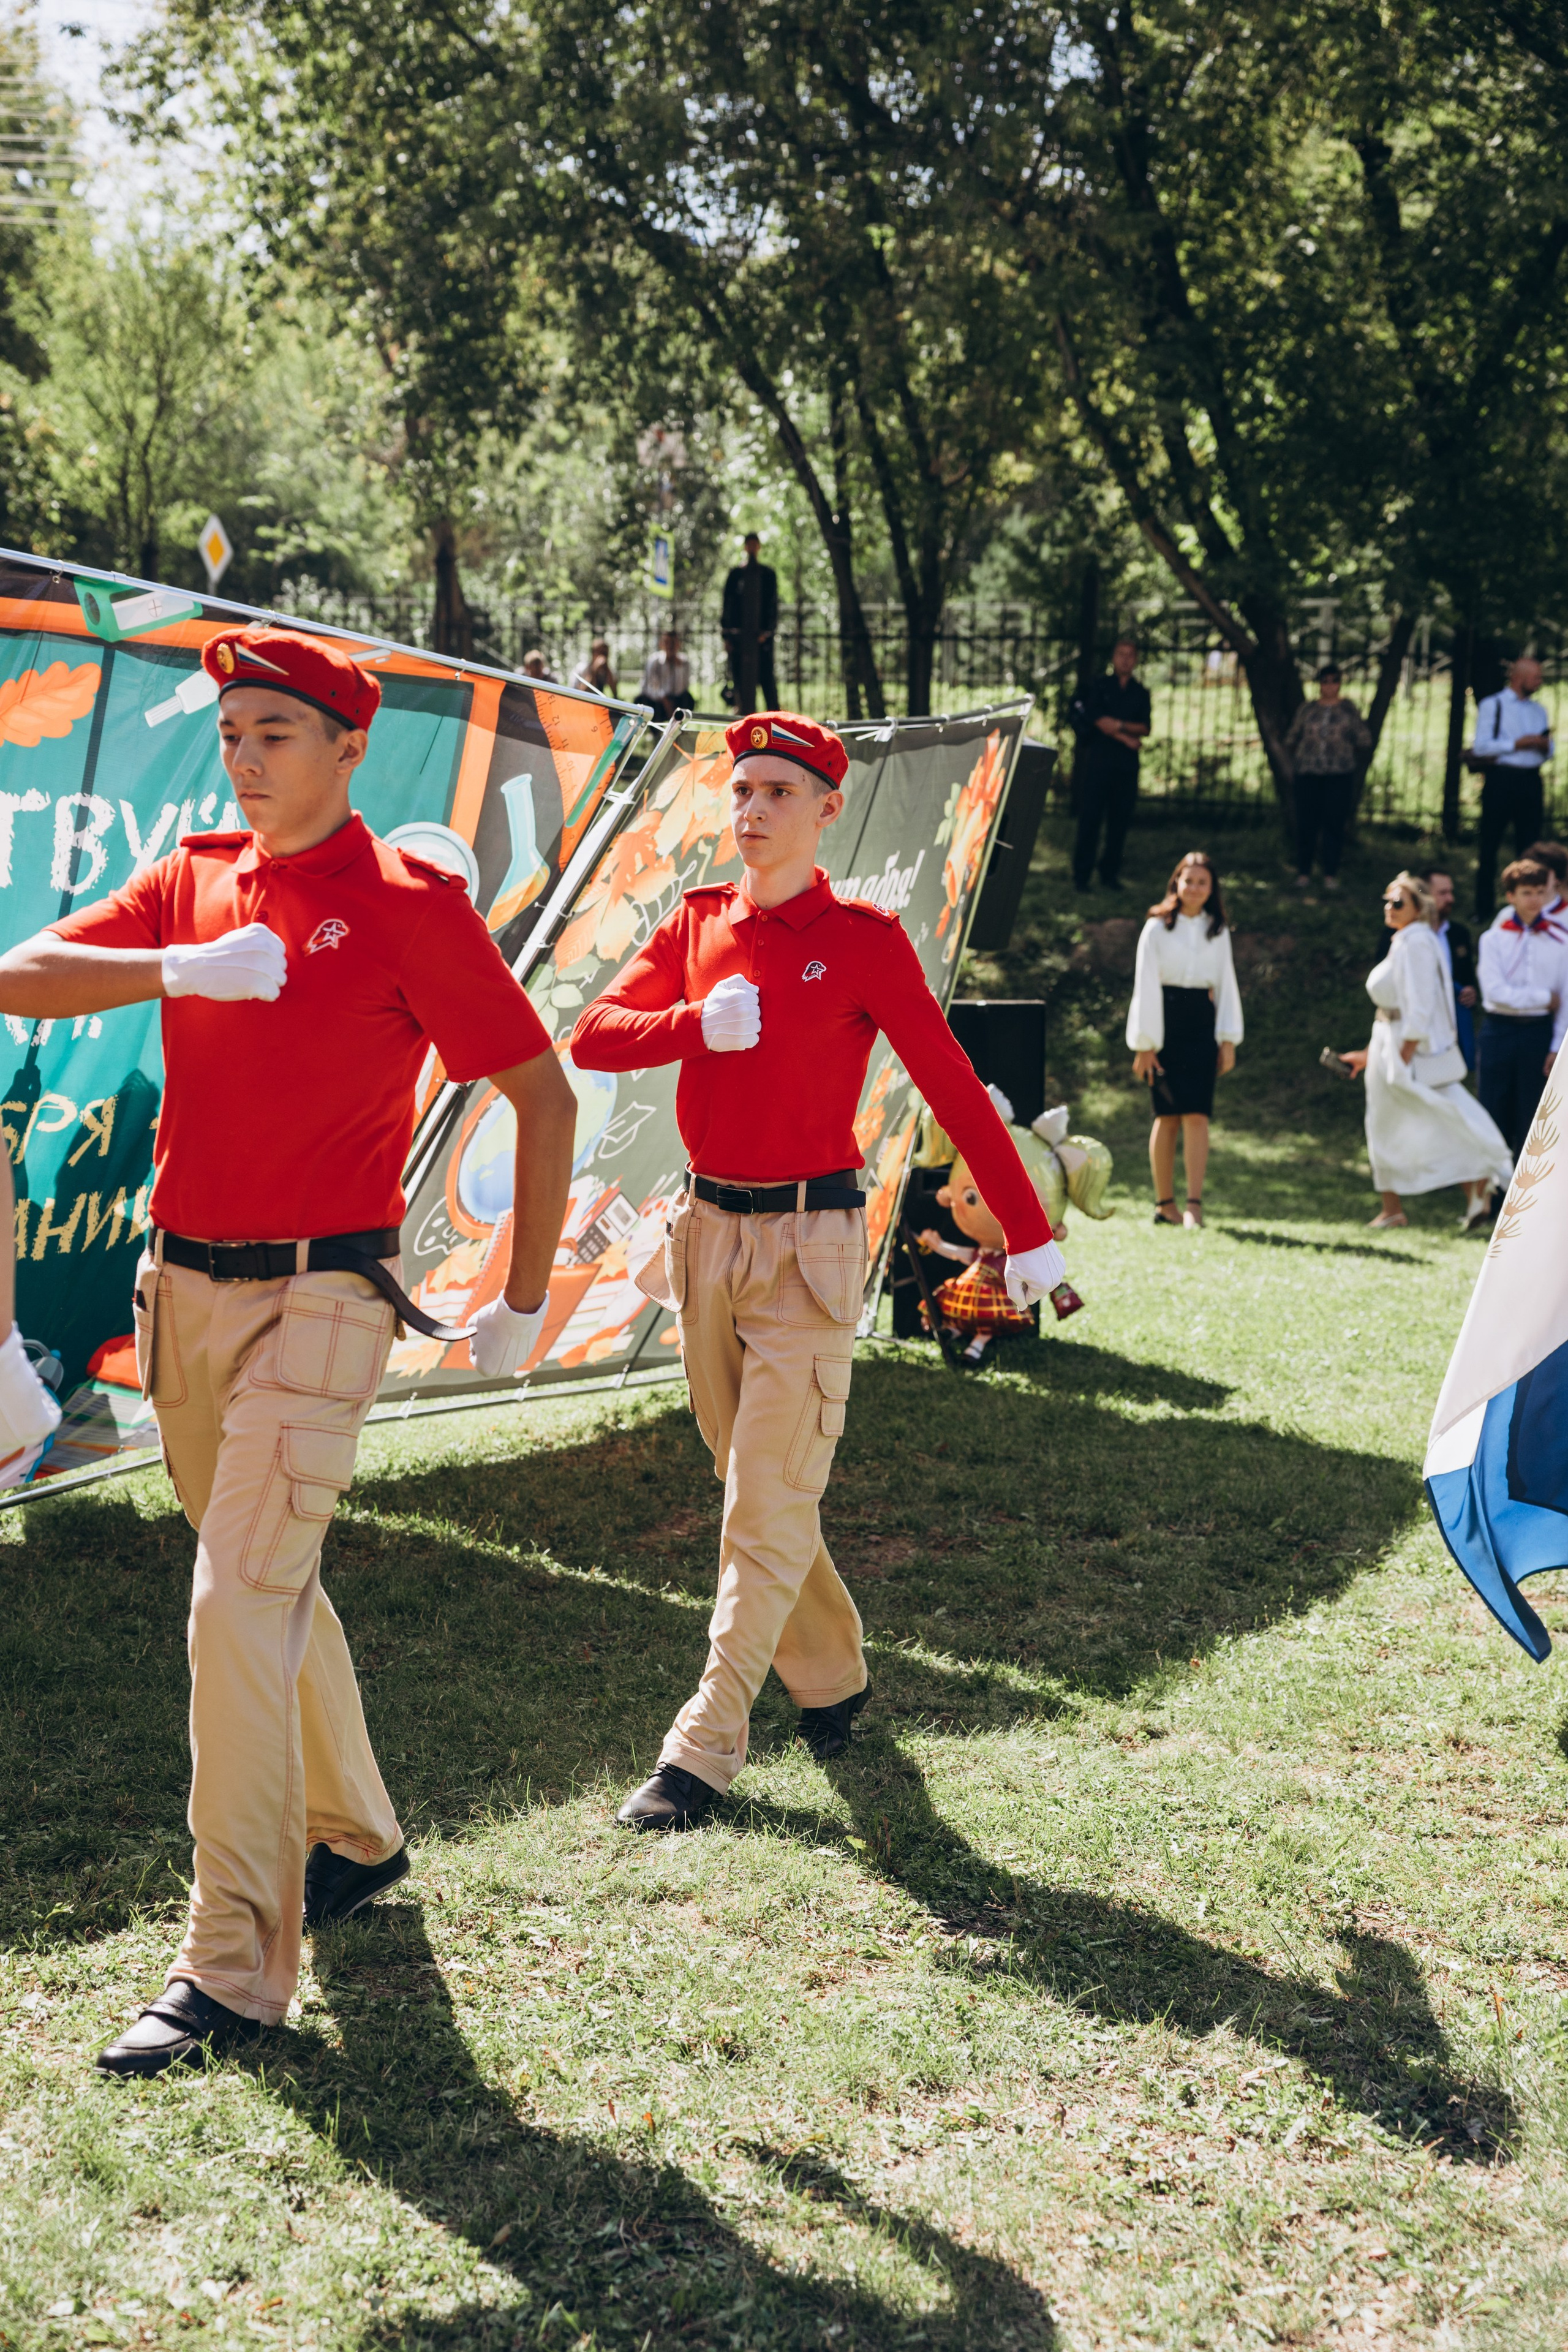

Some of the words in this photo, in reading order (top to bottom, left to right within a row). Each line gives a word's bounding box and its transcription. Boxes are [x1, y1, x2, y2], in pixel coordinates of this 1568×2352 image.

[548, 695, 556, 705] 13
[552, 715, 560, 726] 12
[562, 738, 570, 748] 11
[567, 760, 575, 772] 10
